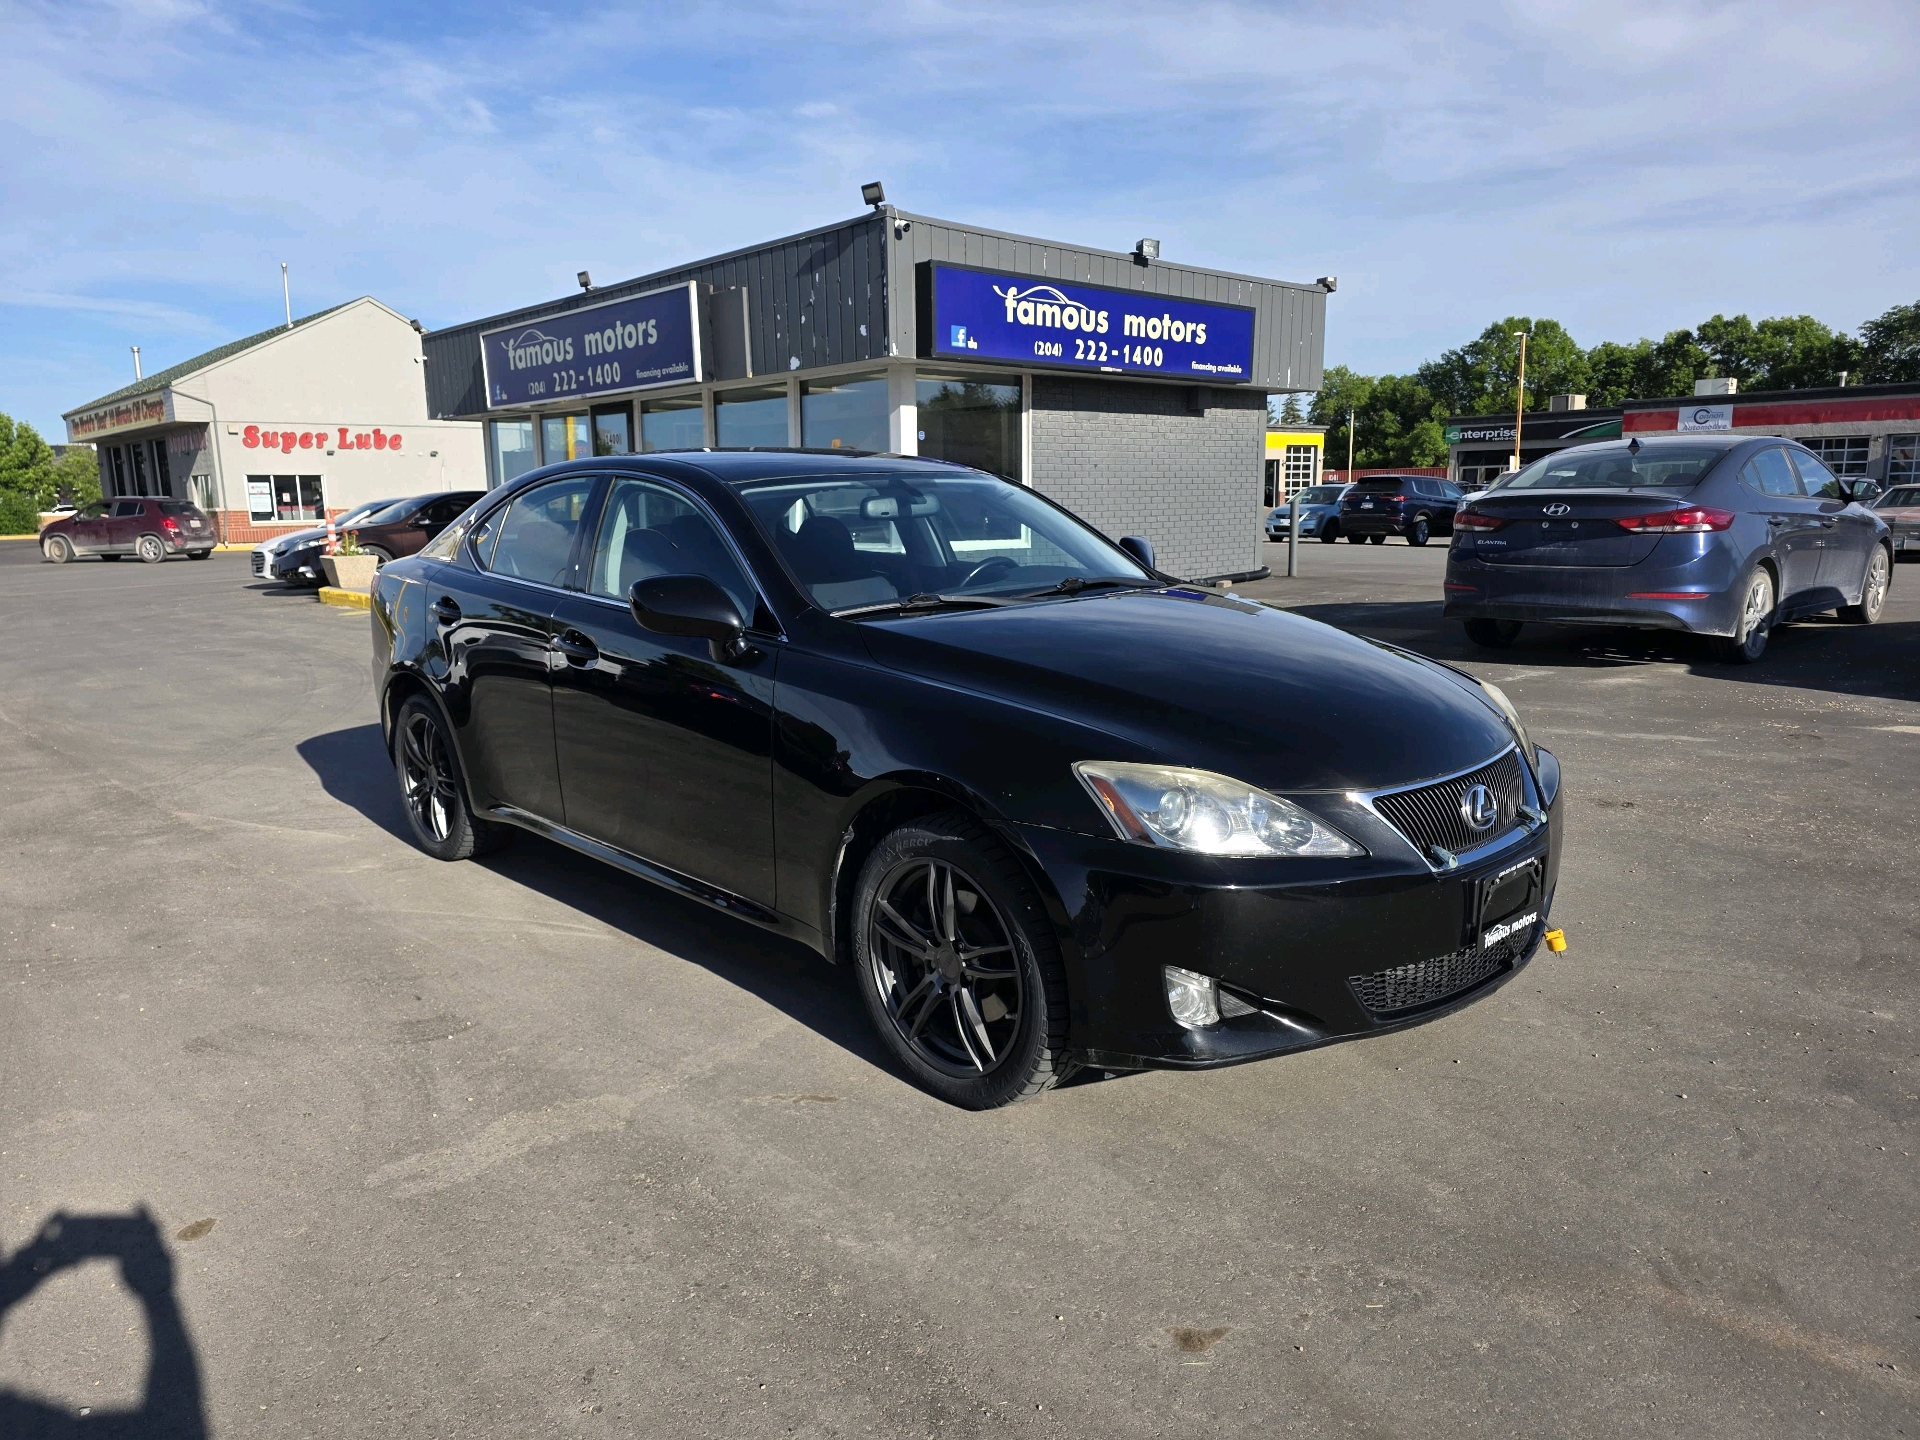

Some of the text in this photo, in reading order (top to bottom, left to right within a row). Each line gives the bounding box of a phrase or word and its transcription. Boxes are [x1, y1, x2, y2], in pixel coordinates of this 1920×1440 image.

[1004, 285, 1206, 344] famous motors
[507, 318, 658, 371] famous motors
[1034, 340, 1063, 358] (204)
[636, 362, 689, 379] financing available
[1191, 360, 1243, 375] financing available
[528, 380, 546, 395] (204)
[243, 426, 403, 453] Super Lube
[1447, 427, 1518, 441] enterprise
[1485, 912, 1537, 949] famous motors
